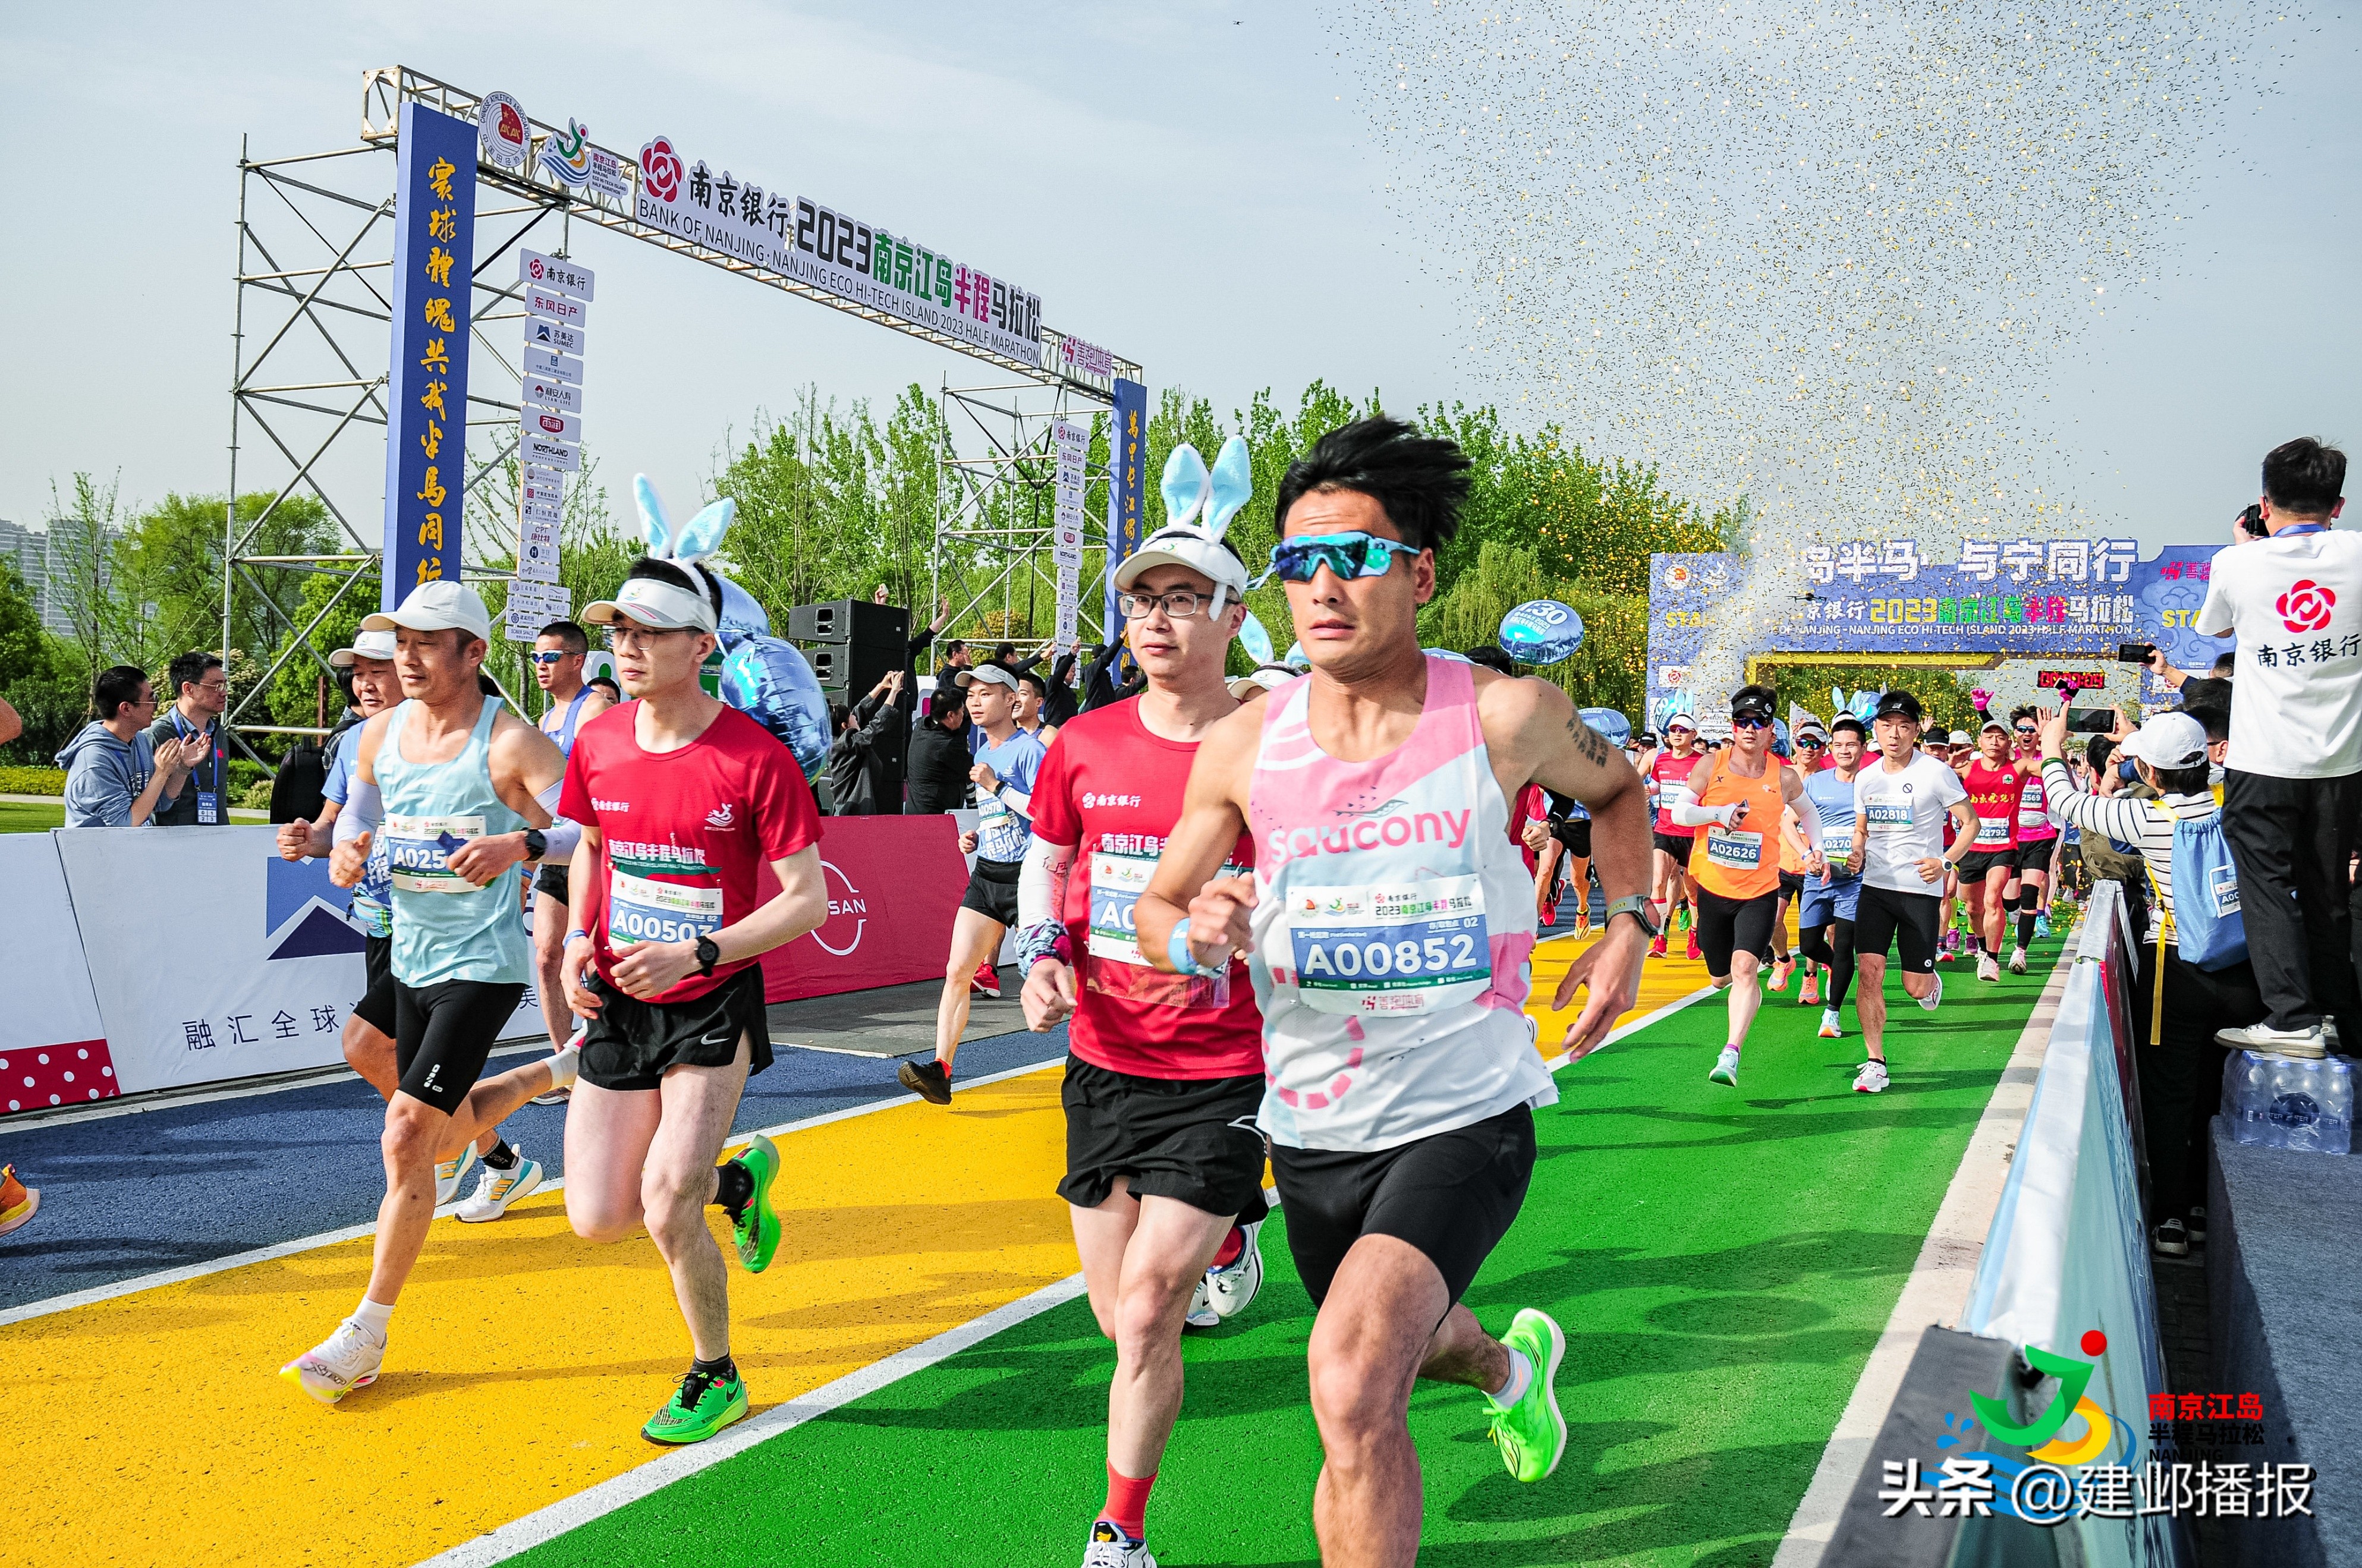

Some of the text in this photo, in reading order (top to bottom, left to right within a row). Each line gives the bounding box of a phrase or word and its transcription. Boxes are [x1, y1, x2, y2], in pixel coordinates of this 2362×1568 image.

[490, 93, 512, 106] ATHLETICS
[512, 103, 530, 141] ASSOCIATION
[690, 165, 789, 239] 南京银行
[546, 266, 586, 291] 南京银行
[639, 199, 680, 231] BANK
[683, 216, 702, 238] OF
[831, 272, 853, 294] ECO
[856, 284, 899, 311] HI-TECH
[902, 299, 939, 326] ISLAND
[941, 314, 964, 335] 2023
[965, 321, 989, 344] HALF
[991, 333, 1039, 364] MARATHON
[534, 296, 578, 317] 东风日产
[553, 329, 574, 342] 苏美达
[553, 339, 574, 349] SUMEC
[533, 443, 568, 458] NORTHLAND
[1062, 451, 1083, 465] 东风日产
[1959, 540, 2138, 582] 与宁同行
[1518, 602, 1568, 625] 1:30
[1806, 599, 1868, 621] 京银行
[1849, 625, 1896, 634] NANJING
[1898, 625, 1919, 634] ECO
[1921, 625, 1962, 634] HI-TECH
[1967, 625, 2006, 634] ISLAND
[2008, 625, 2034, 634] 2023
[2257, 633, 2361, 667] 南京银行
[1096, 795, 1141, 808] 南京银行
[1869, 809, 1908, 820] A02818
[1268, 809, 1471, 862] saucony
[1823, 839, 1851, 849] 0270
[1710, 842, 1757, 859] A02626
[1463, 917, 1479, 928] 02
[1304, 933, 1478, 977] A00852
